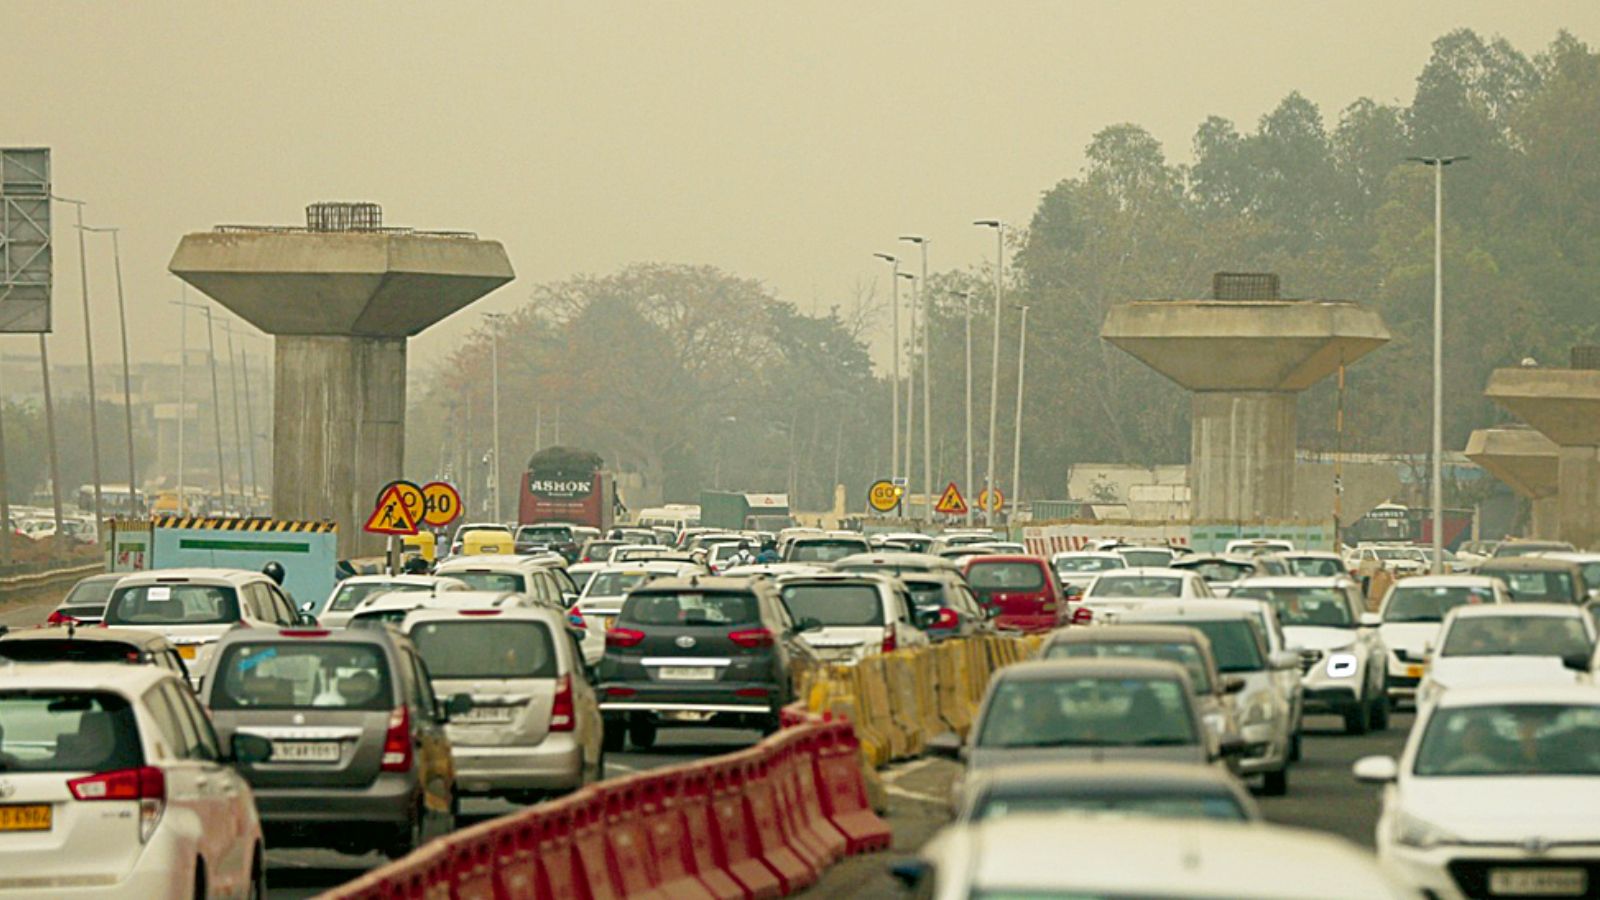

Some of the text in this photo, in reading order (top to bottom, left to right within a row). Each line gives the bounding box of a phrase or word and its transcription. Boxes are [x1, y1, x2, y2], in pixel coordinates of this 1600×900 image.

[531, 481, 591, 492] ASHOK
[875, 487, 894, 497] GO
[426, 494, 450, 512] 40
